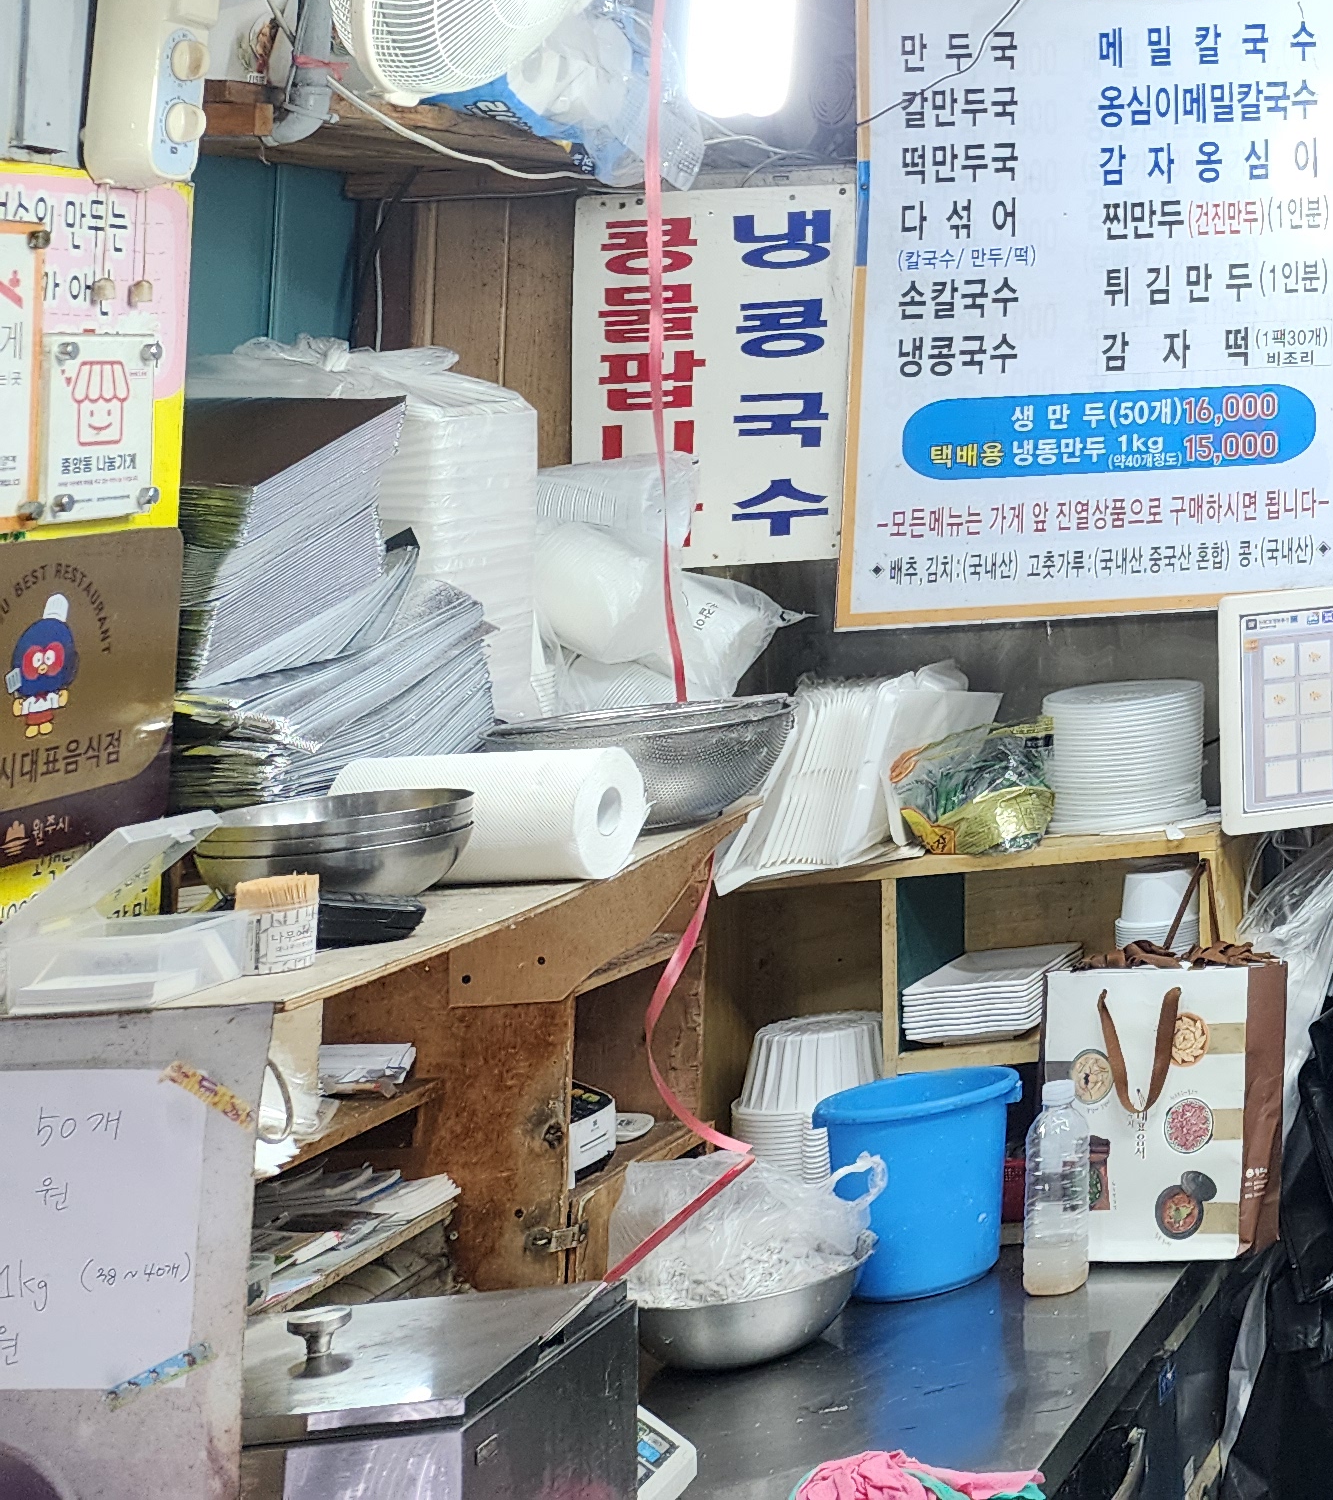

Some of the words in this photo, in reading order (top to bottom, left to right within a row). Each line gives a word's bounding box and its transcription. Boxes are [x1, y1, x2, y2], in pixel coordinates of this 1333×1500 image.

[901, 84, 1019, 130] 칼만두국
[1098, 79, 1319, 129] 옹심이메밀칼국수
[901, 141, 1019, 185] 떡만두국
[899, 276, 1020, 321] 손칼국수
[897, 332, 1019, 378] 냉콩국수
[1254, 326, 1330, 351] (1팩30개)
[1265, 349, 1316, 367] 비조리
[730, 209, 832, 537] 냉콩국수
[1182, 391, 1280, 427] 16,000
[928, 440, 1006, 470] 택배용
[1012, 434, 1108, 468] 냉동만두
[1116, 433, 1166, 457] 1kg
[1182, 430, 1280, 467] 15,000
[987, 503, 1027, 536] 가게
[1031, 502, 1050, 535] 앞
[1054, 495, 1164, 534] 진열상품으로
[1168, 490, 1259, 528] 구매하시면
[14, 563, 49, 598] BEST
[54, 561, 112, 655] RESTAURANT
[31, 814, 72, 847] 원주시
[34, 1176, 69, 1211] 원
